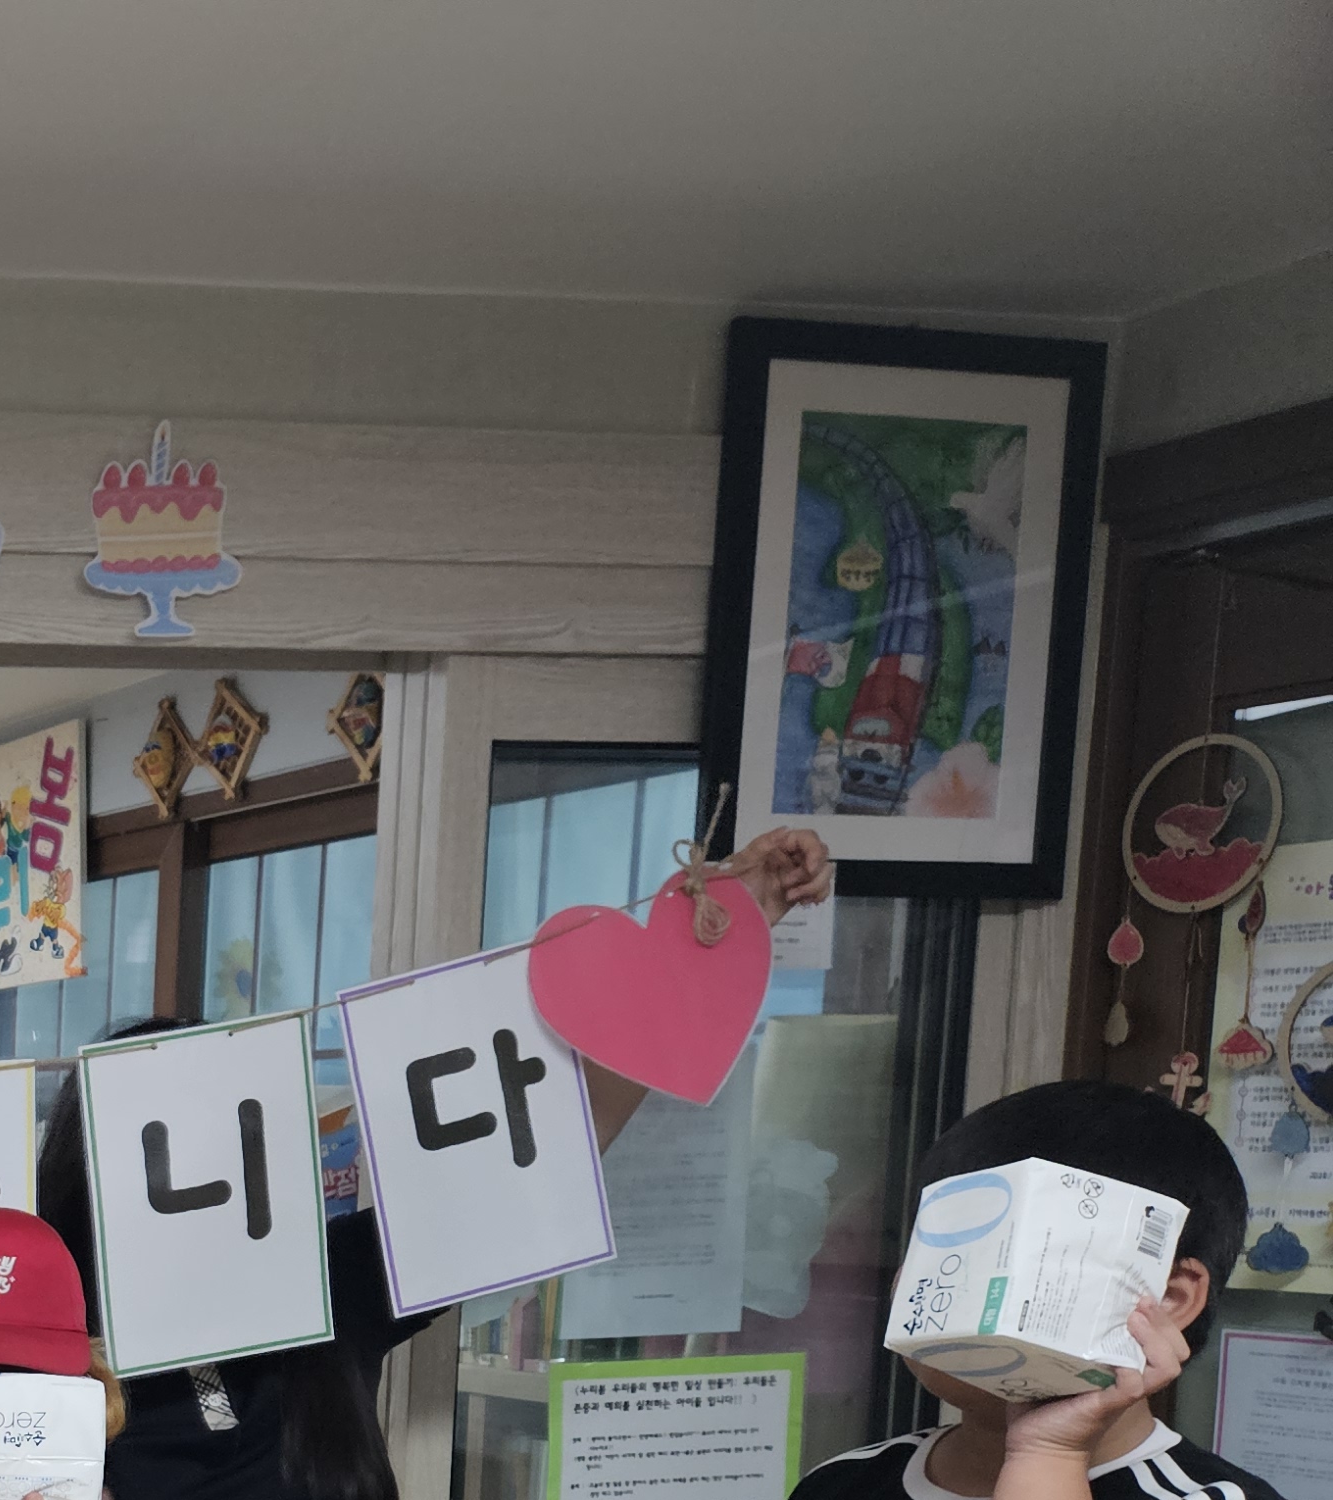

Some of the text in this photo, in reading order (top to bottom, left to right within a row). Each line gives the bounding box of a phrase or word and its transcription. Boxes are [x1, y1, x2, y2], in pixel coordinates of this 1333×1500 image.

[405, 1028, 545, 1169] 다
[141, 1098, 272, 1241] 니
[924, 1254, 961, 1333] zero
